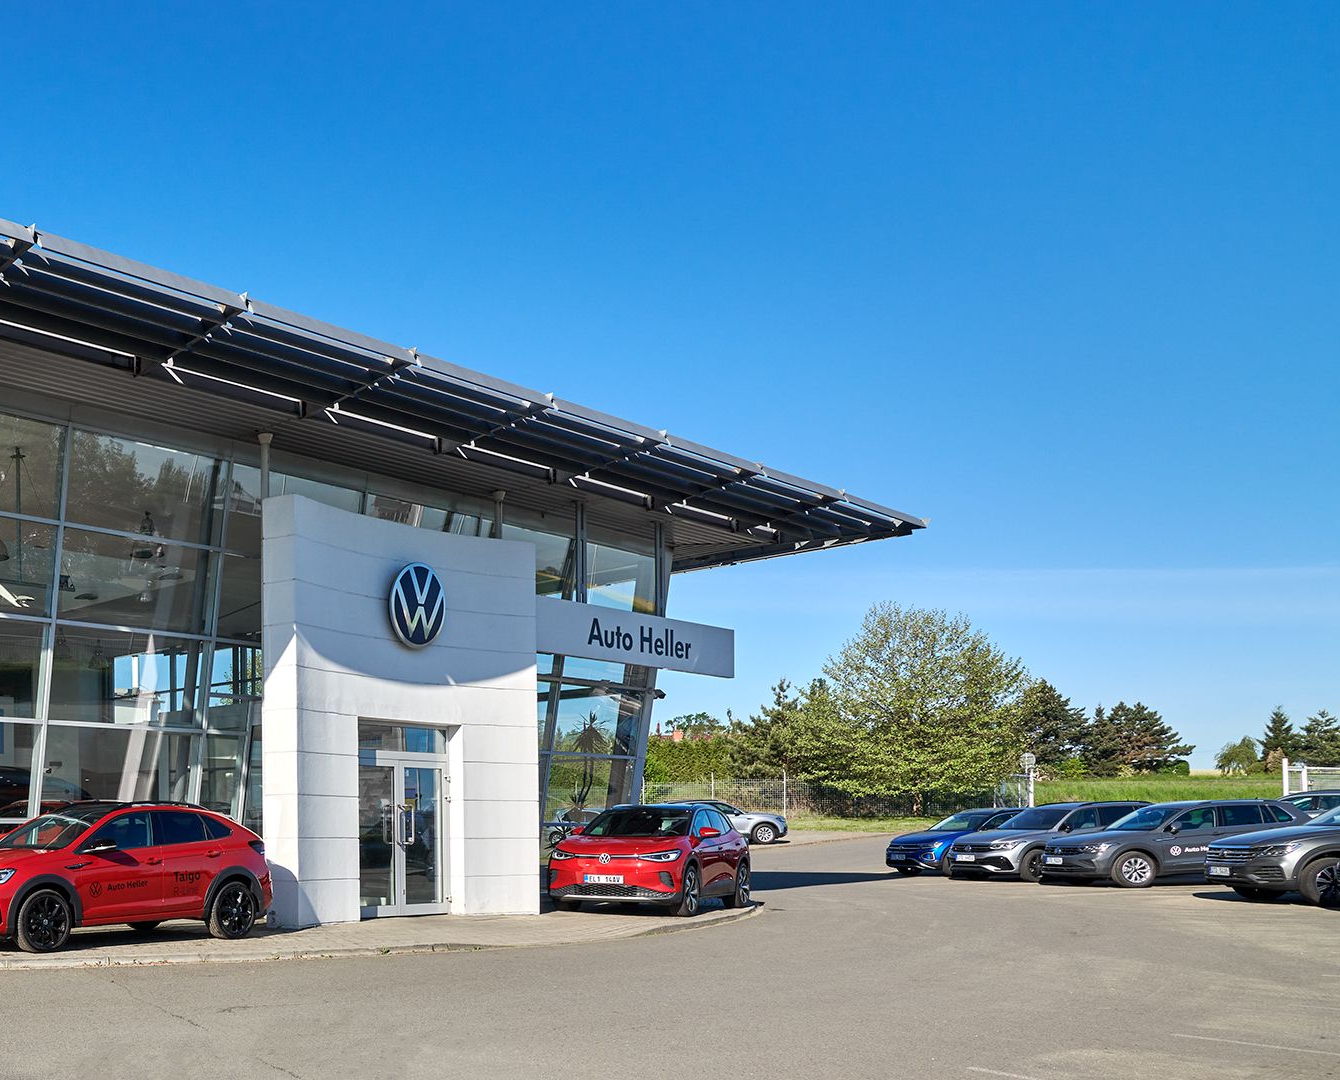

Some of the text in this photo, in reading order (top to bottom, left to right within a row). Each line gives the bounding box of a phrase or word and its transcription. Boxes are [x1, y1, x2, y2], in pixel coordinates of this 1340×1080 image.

[588, 618, 691, 659] Auto Heller
[173, 871, 201, 883] Taigo
[107, 880, 148, 892] Auto Heller
